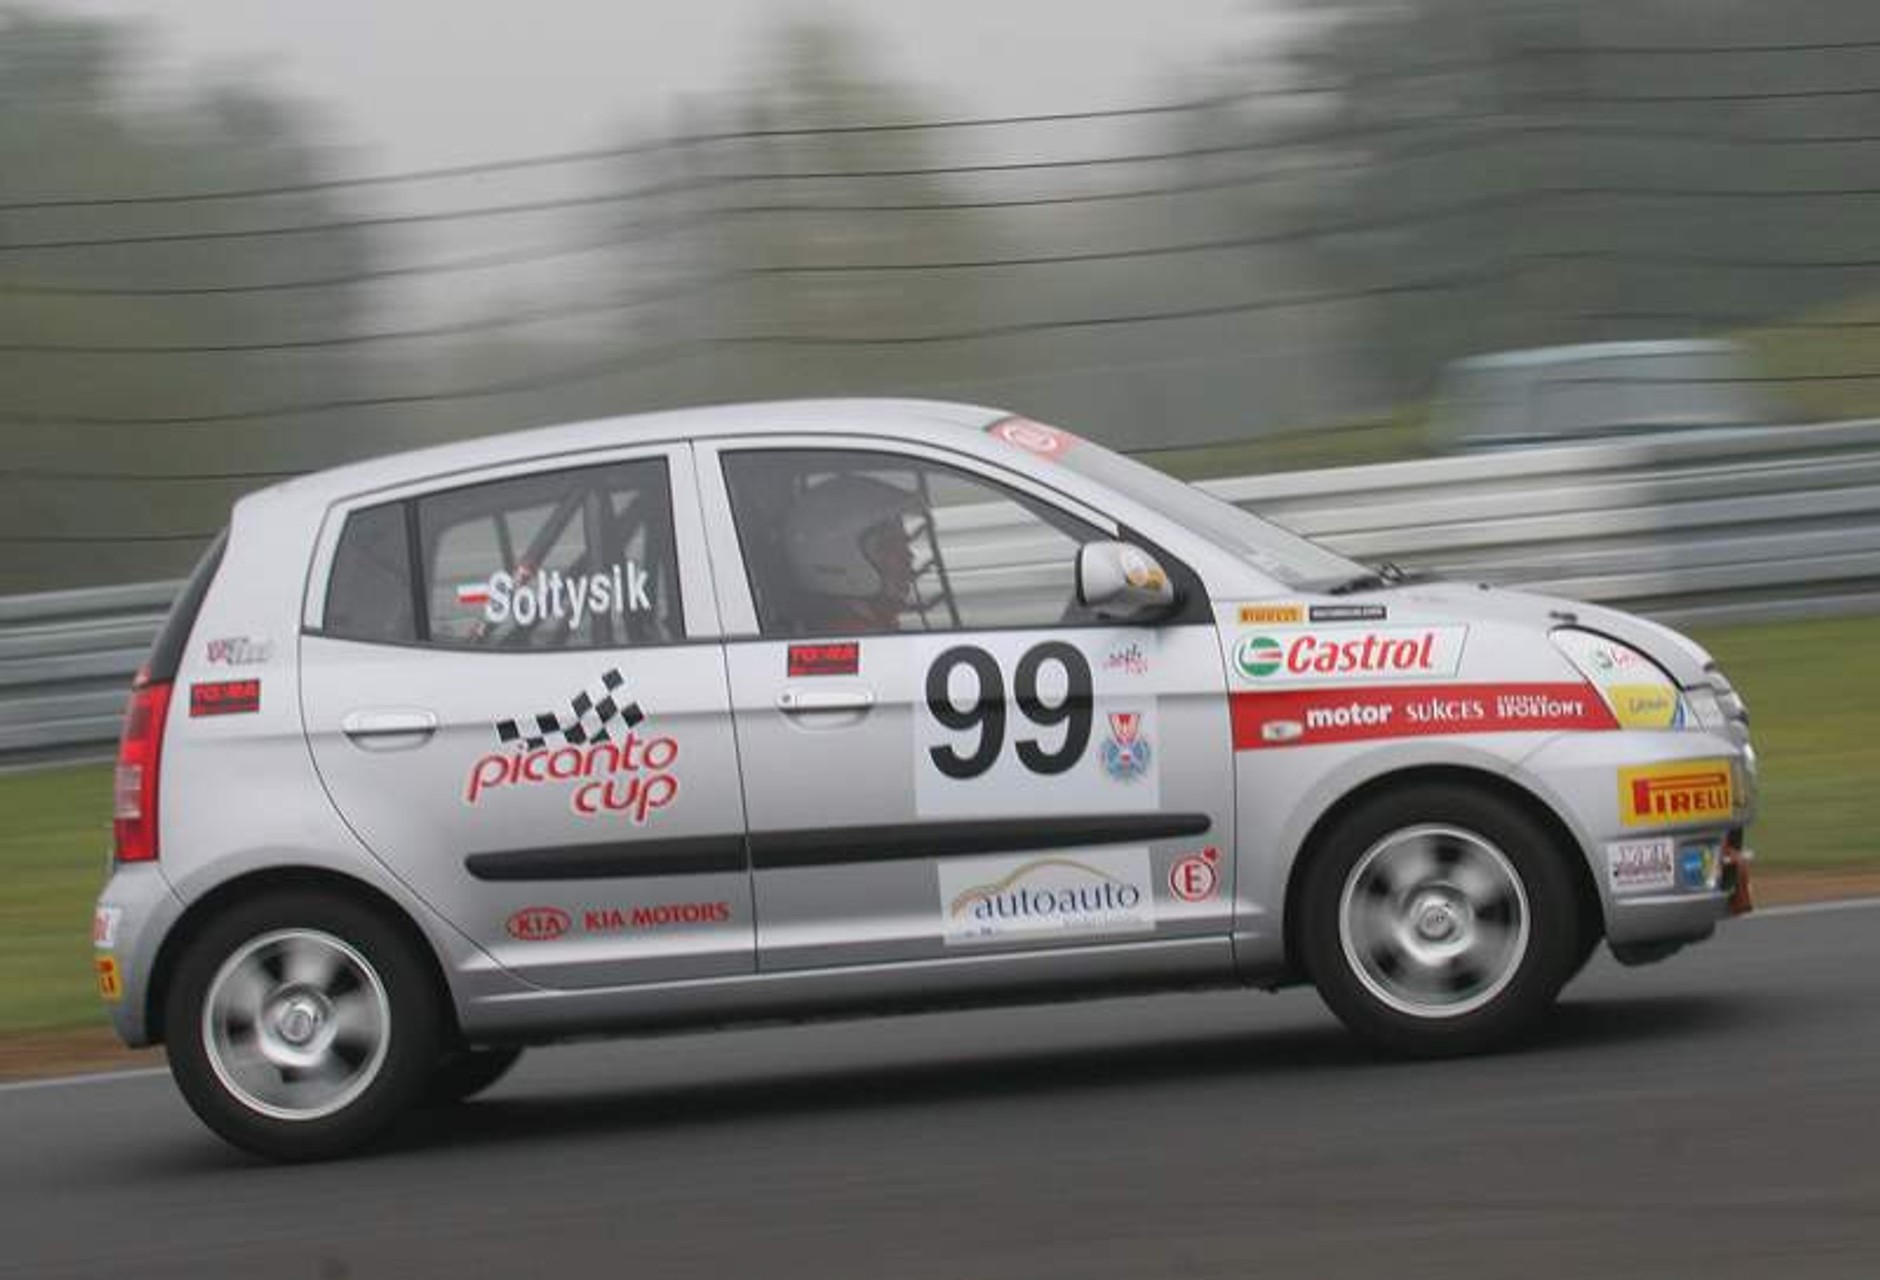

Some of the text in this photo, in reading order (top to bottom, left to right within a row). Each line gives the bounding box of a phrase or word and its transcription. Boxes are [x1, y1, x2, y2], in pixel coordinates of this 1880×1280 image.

[1287, 633, 1434, 674] Castrol
[925, 640, 1094, 779] 99
[1306, 697, 1485, 727] motor SUKCES
[468, 731, 679, 803] picanto
[573, 774, 679, 822] cup
[1632, 773, 1729, 816] PIRELLI
[518, 902, 730, 933] KIA KIA MOTORS
[974, 883, 1140, 920] autoauto
